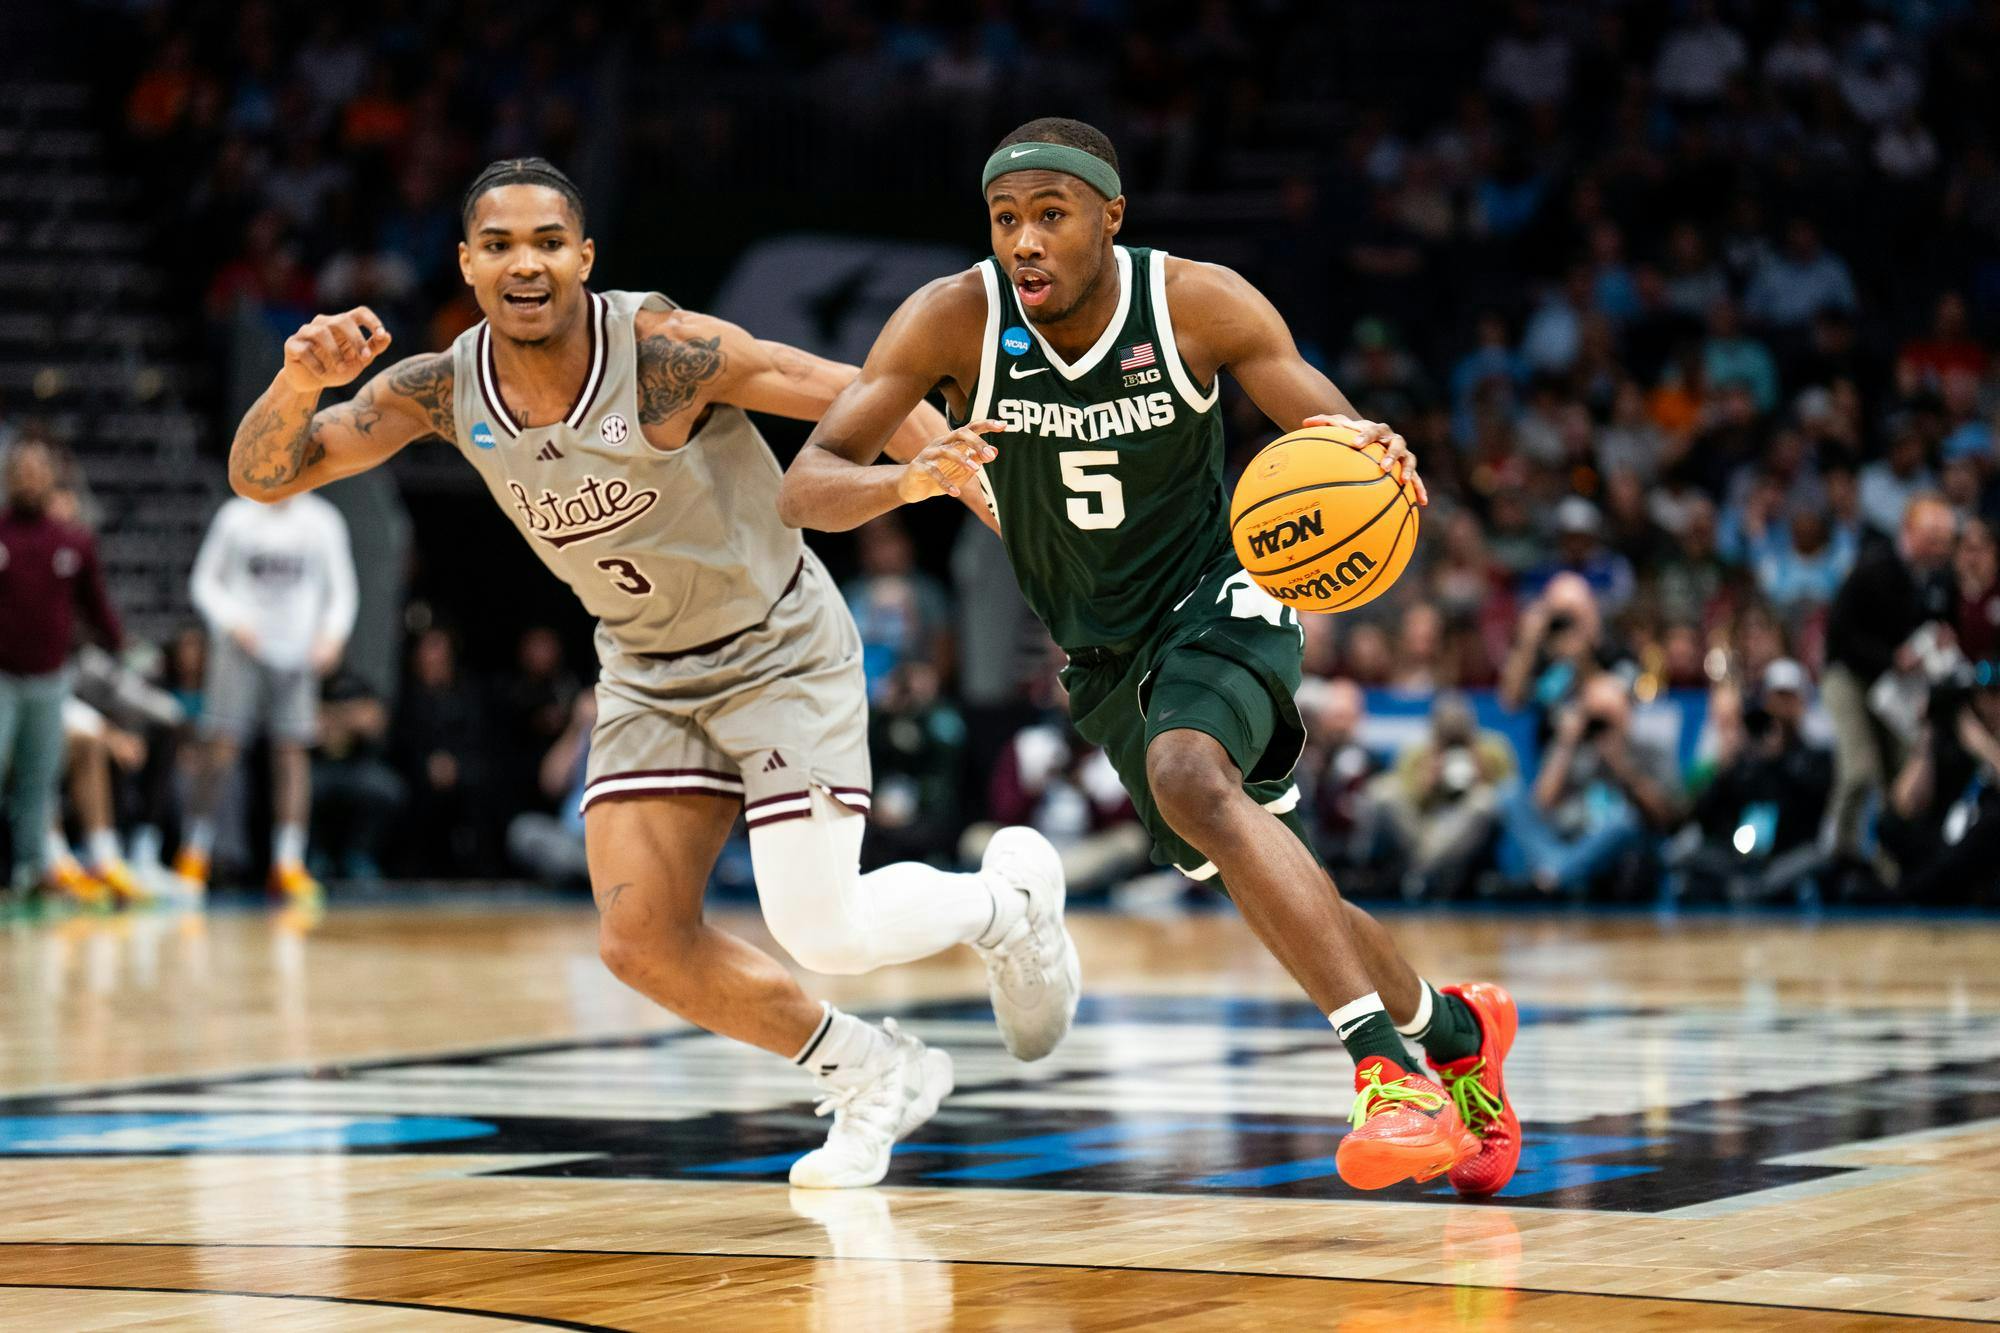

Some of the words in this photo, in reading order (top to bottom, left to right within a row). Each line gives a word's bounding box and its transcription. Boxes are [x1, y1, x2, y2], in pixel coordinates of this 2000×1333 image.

[1004, 338, 1028, 350] NCAA
[601, 415, 628, 444] SEC
[997, 391, 1176, 443] SPARTANS
[509, 476, 658, 549] State
[1058, 450, 1126, 531] 5
[1247, 508, 1325, 560] NCAA
[598, 558, 653, 597] 3
[1259, 551, 1378, 600] Wilson
